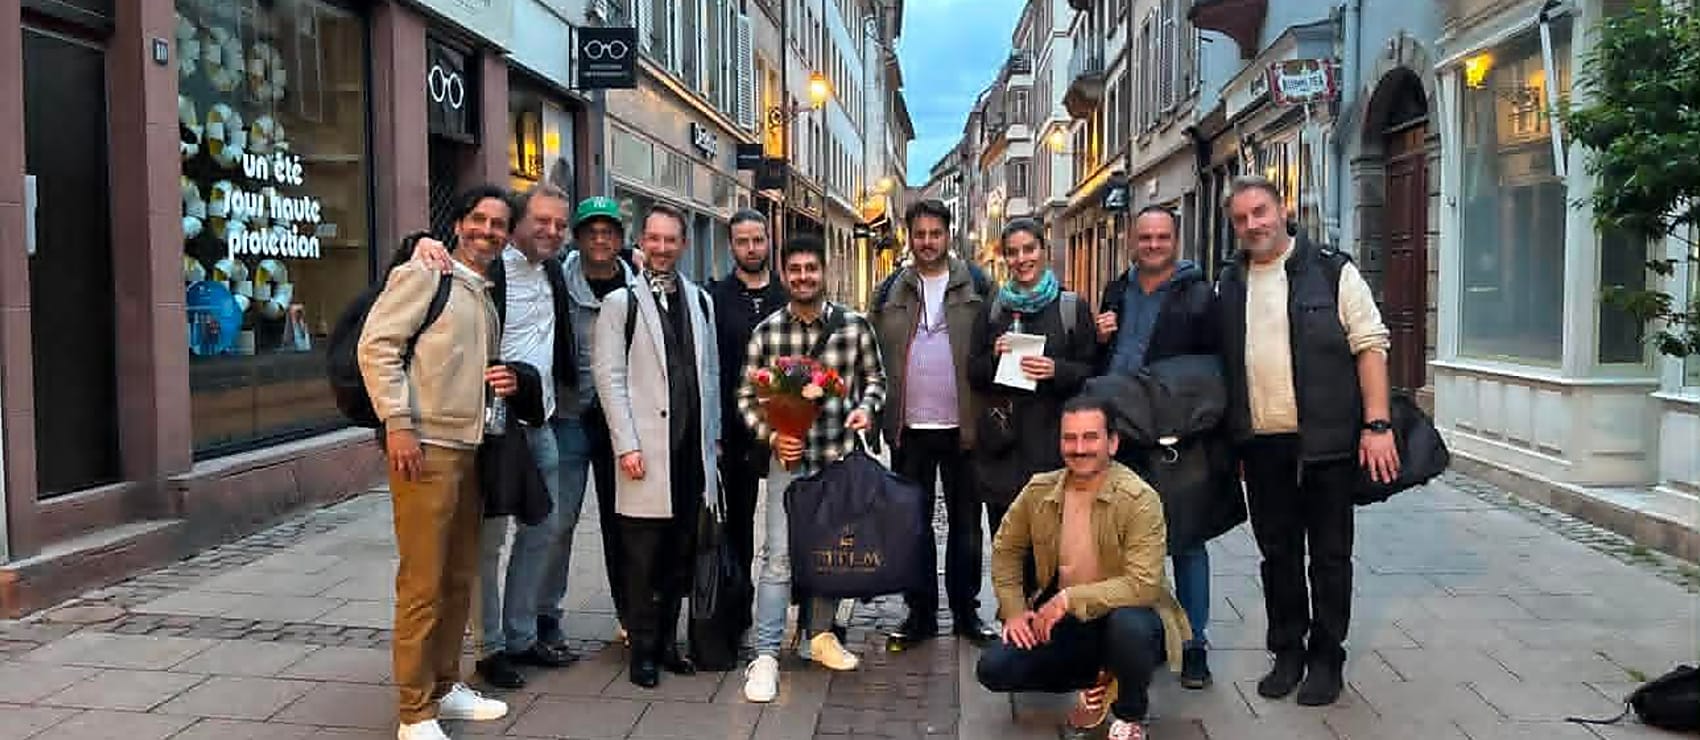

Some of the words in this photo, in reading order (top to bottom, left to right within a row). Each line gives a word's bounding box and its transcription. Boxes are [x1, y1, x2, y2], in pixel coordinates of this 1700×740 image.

[242, 153, 268, 180] un
[273, 151, 303, 185] été
[270, 189, 320, 223] haute
[228, 224, 321, 261] protection
